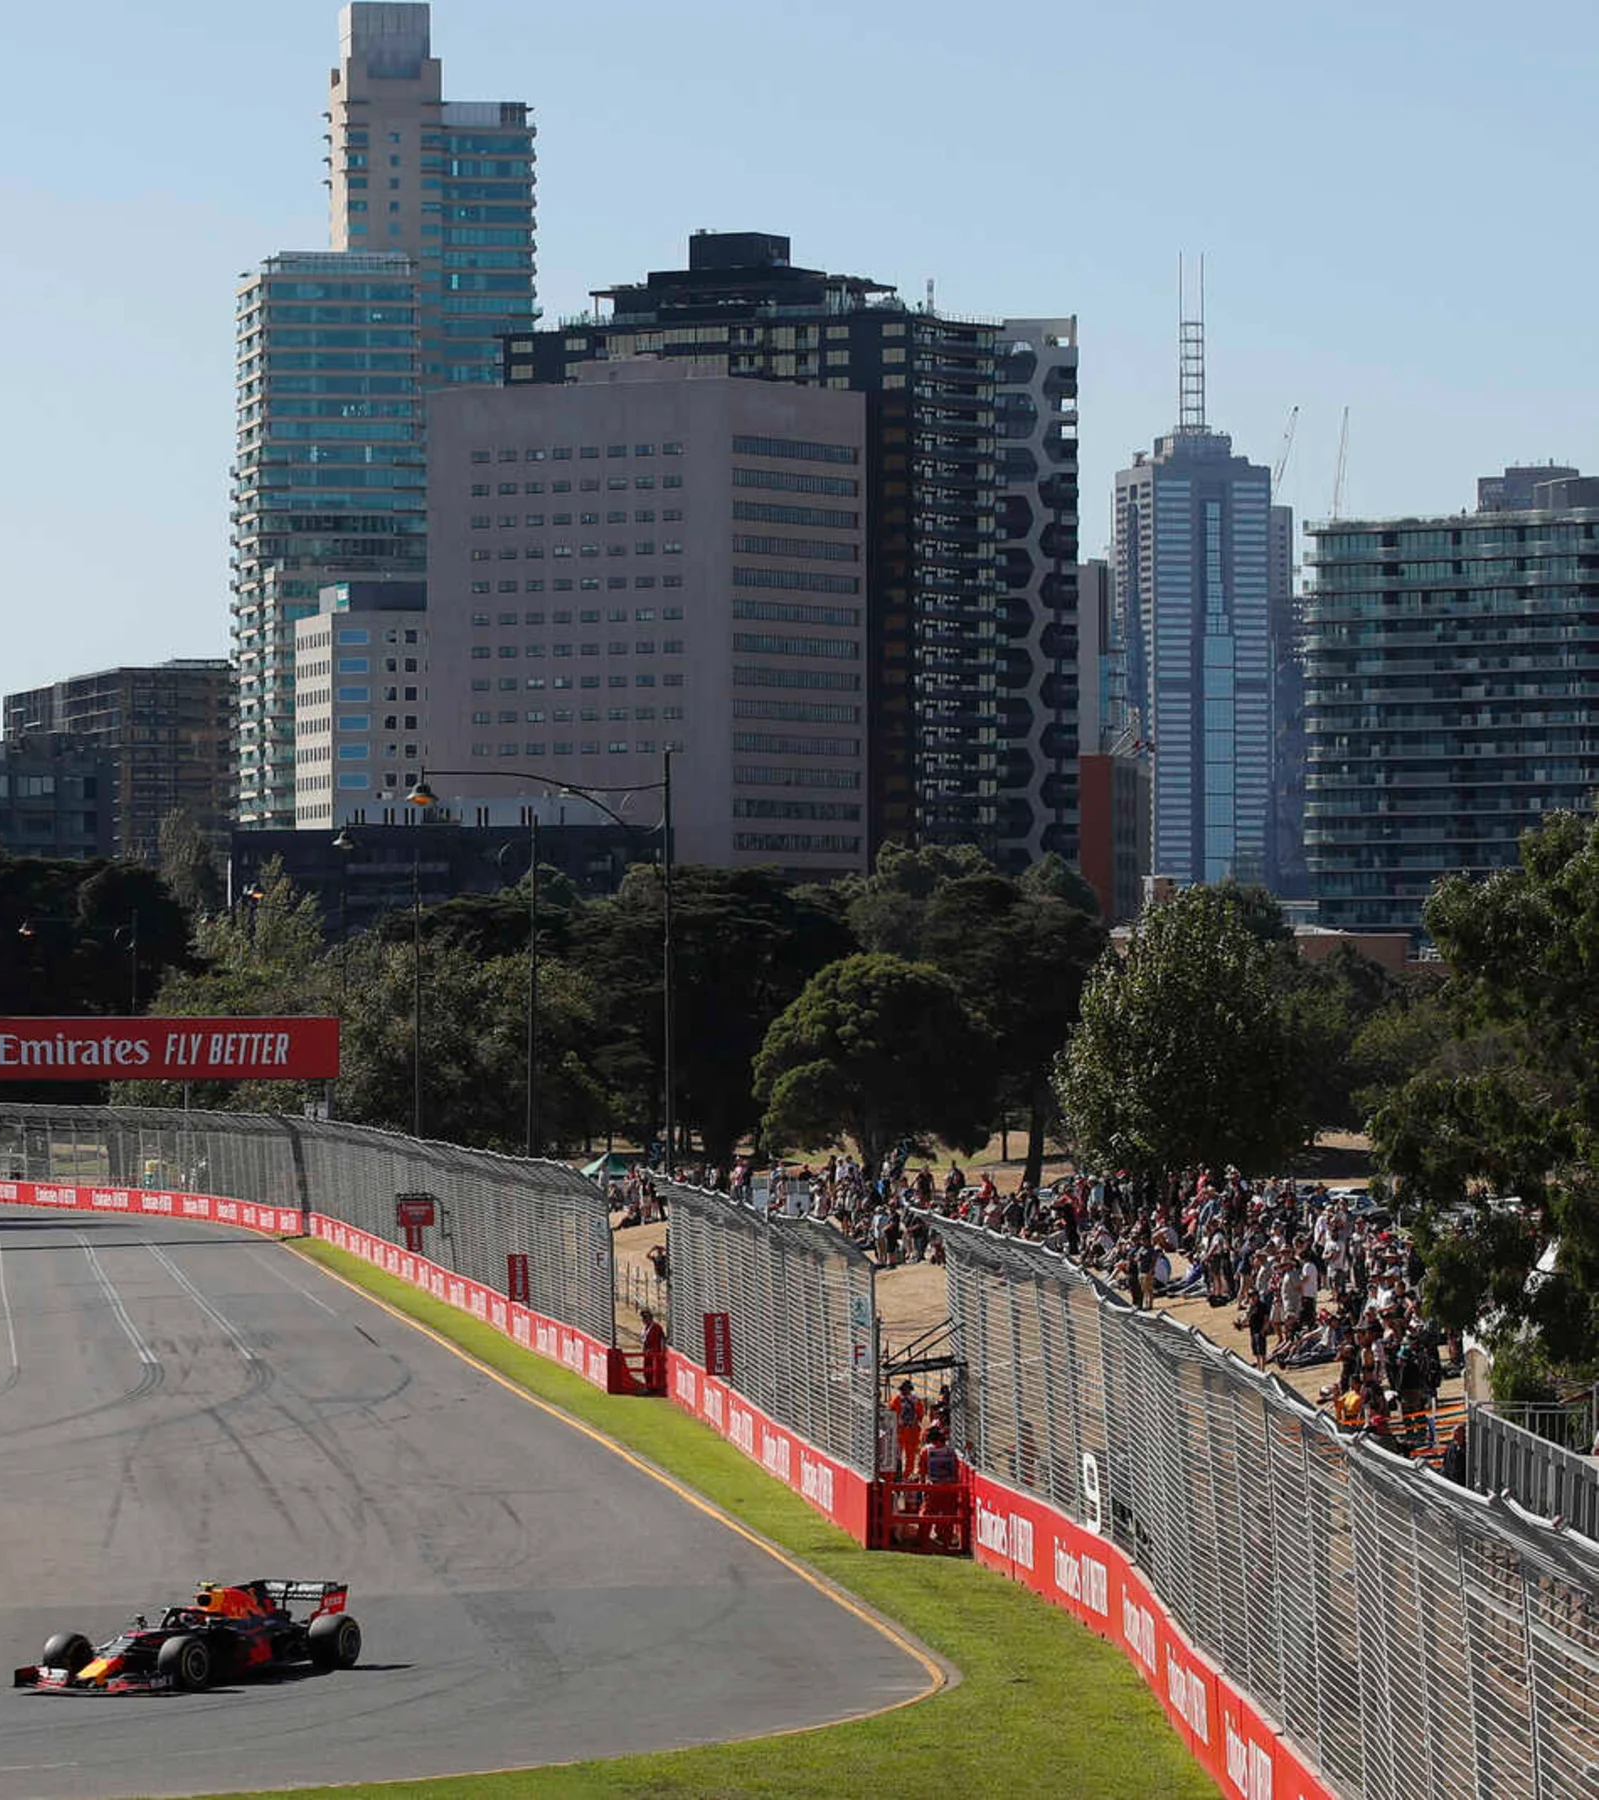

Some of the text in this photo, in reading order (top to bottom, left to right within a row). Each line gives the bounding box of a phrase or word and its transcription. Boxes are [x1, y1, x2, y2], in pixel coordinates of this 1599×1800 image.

[164, 1033, 203, 1065] FLY
[208, 1033, 291, 1065] BETTER
[853, 1344, 866, 1365] F
